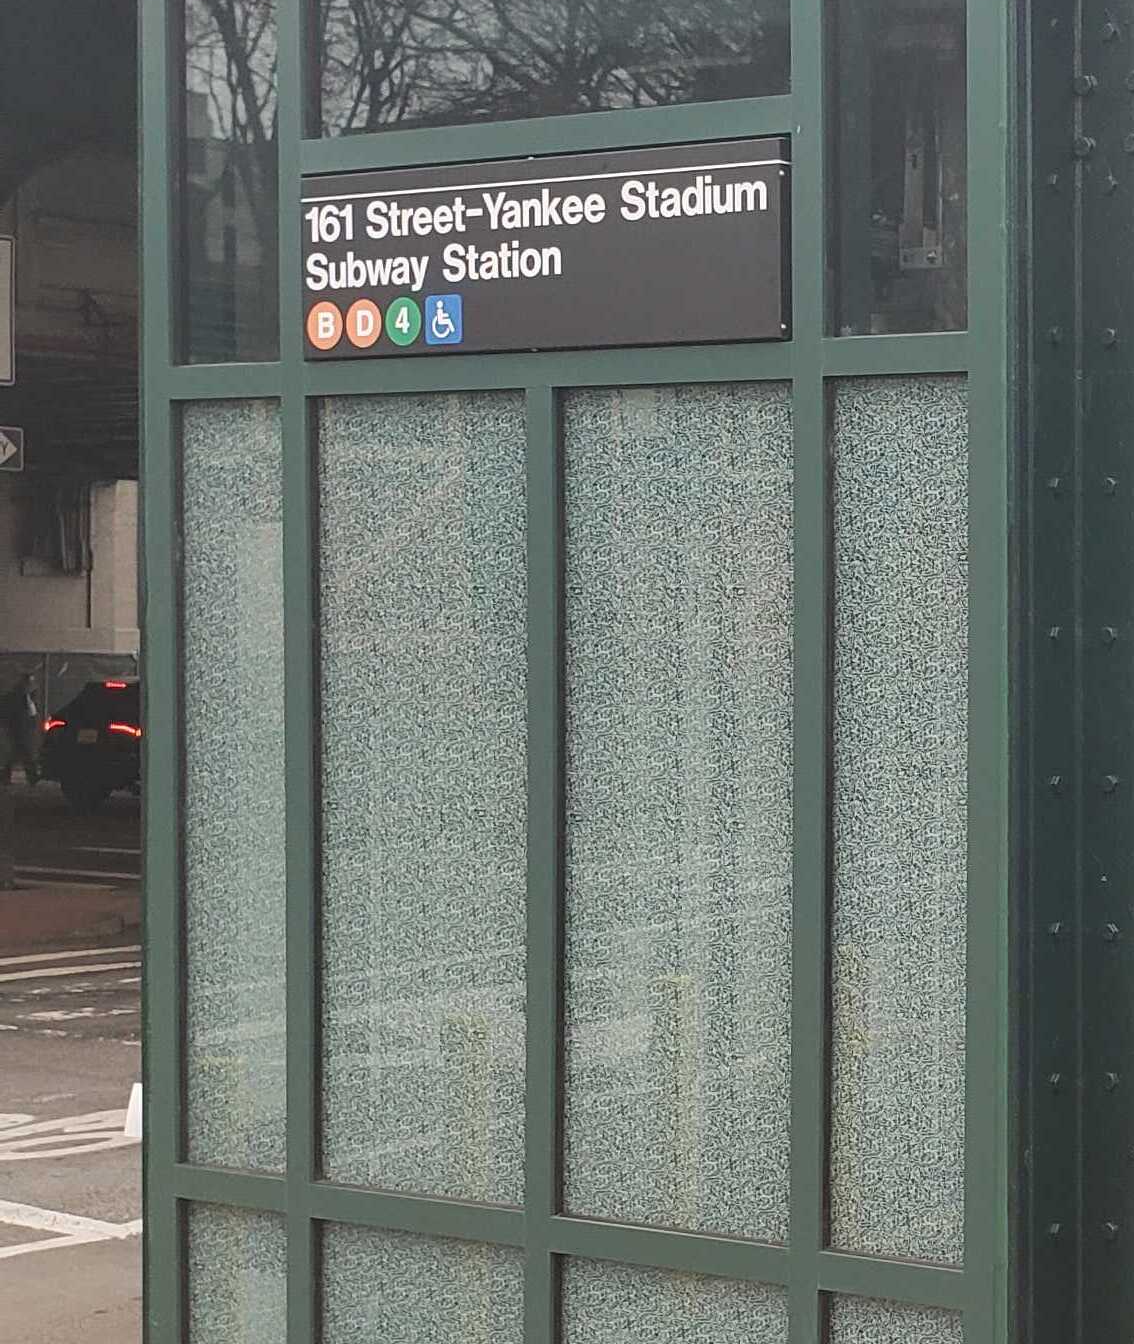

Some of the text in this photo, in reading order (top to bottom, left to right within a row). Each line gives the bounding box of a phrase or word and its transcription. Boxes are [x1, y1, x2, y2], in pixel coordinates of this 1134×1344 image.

[305, 175, 768, 243] 161 Street-Yankee Stadium
[306, 240, 562, 291] Subway Station
[317, 307, 409, 338] B D 4
